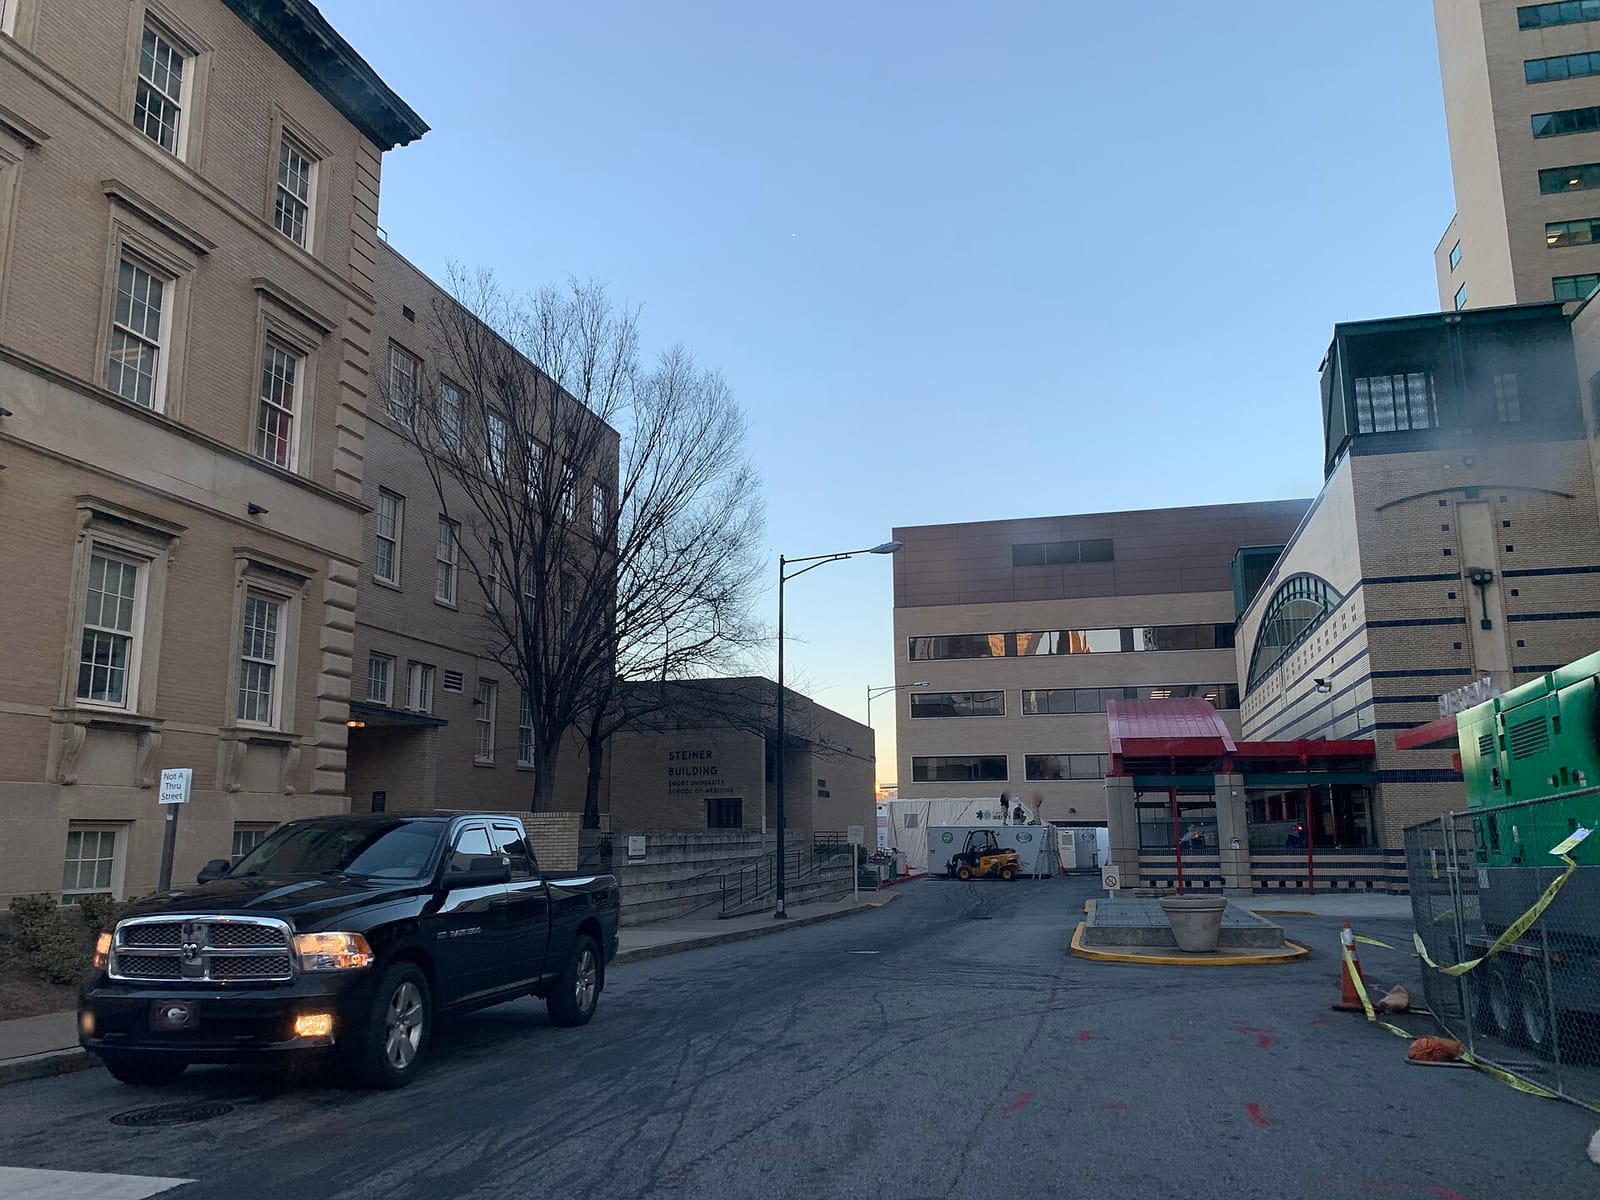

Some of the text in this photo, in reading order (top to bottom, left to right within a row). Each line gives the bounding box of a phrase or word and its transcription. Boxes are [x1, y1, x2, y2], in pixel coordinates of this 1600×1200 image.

[668, 750, 713, 760] STEINER
[668, 766, 718, 776] BUILDING
[161, 792, 183, 800] Street
